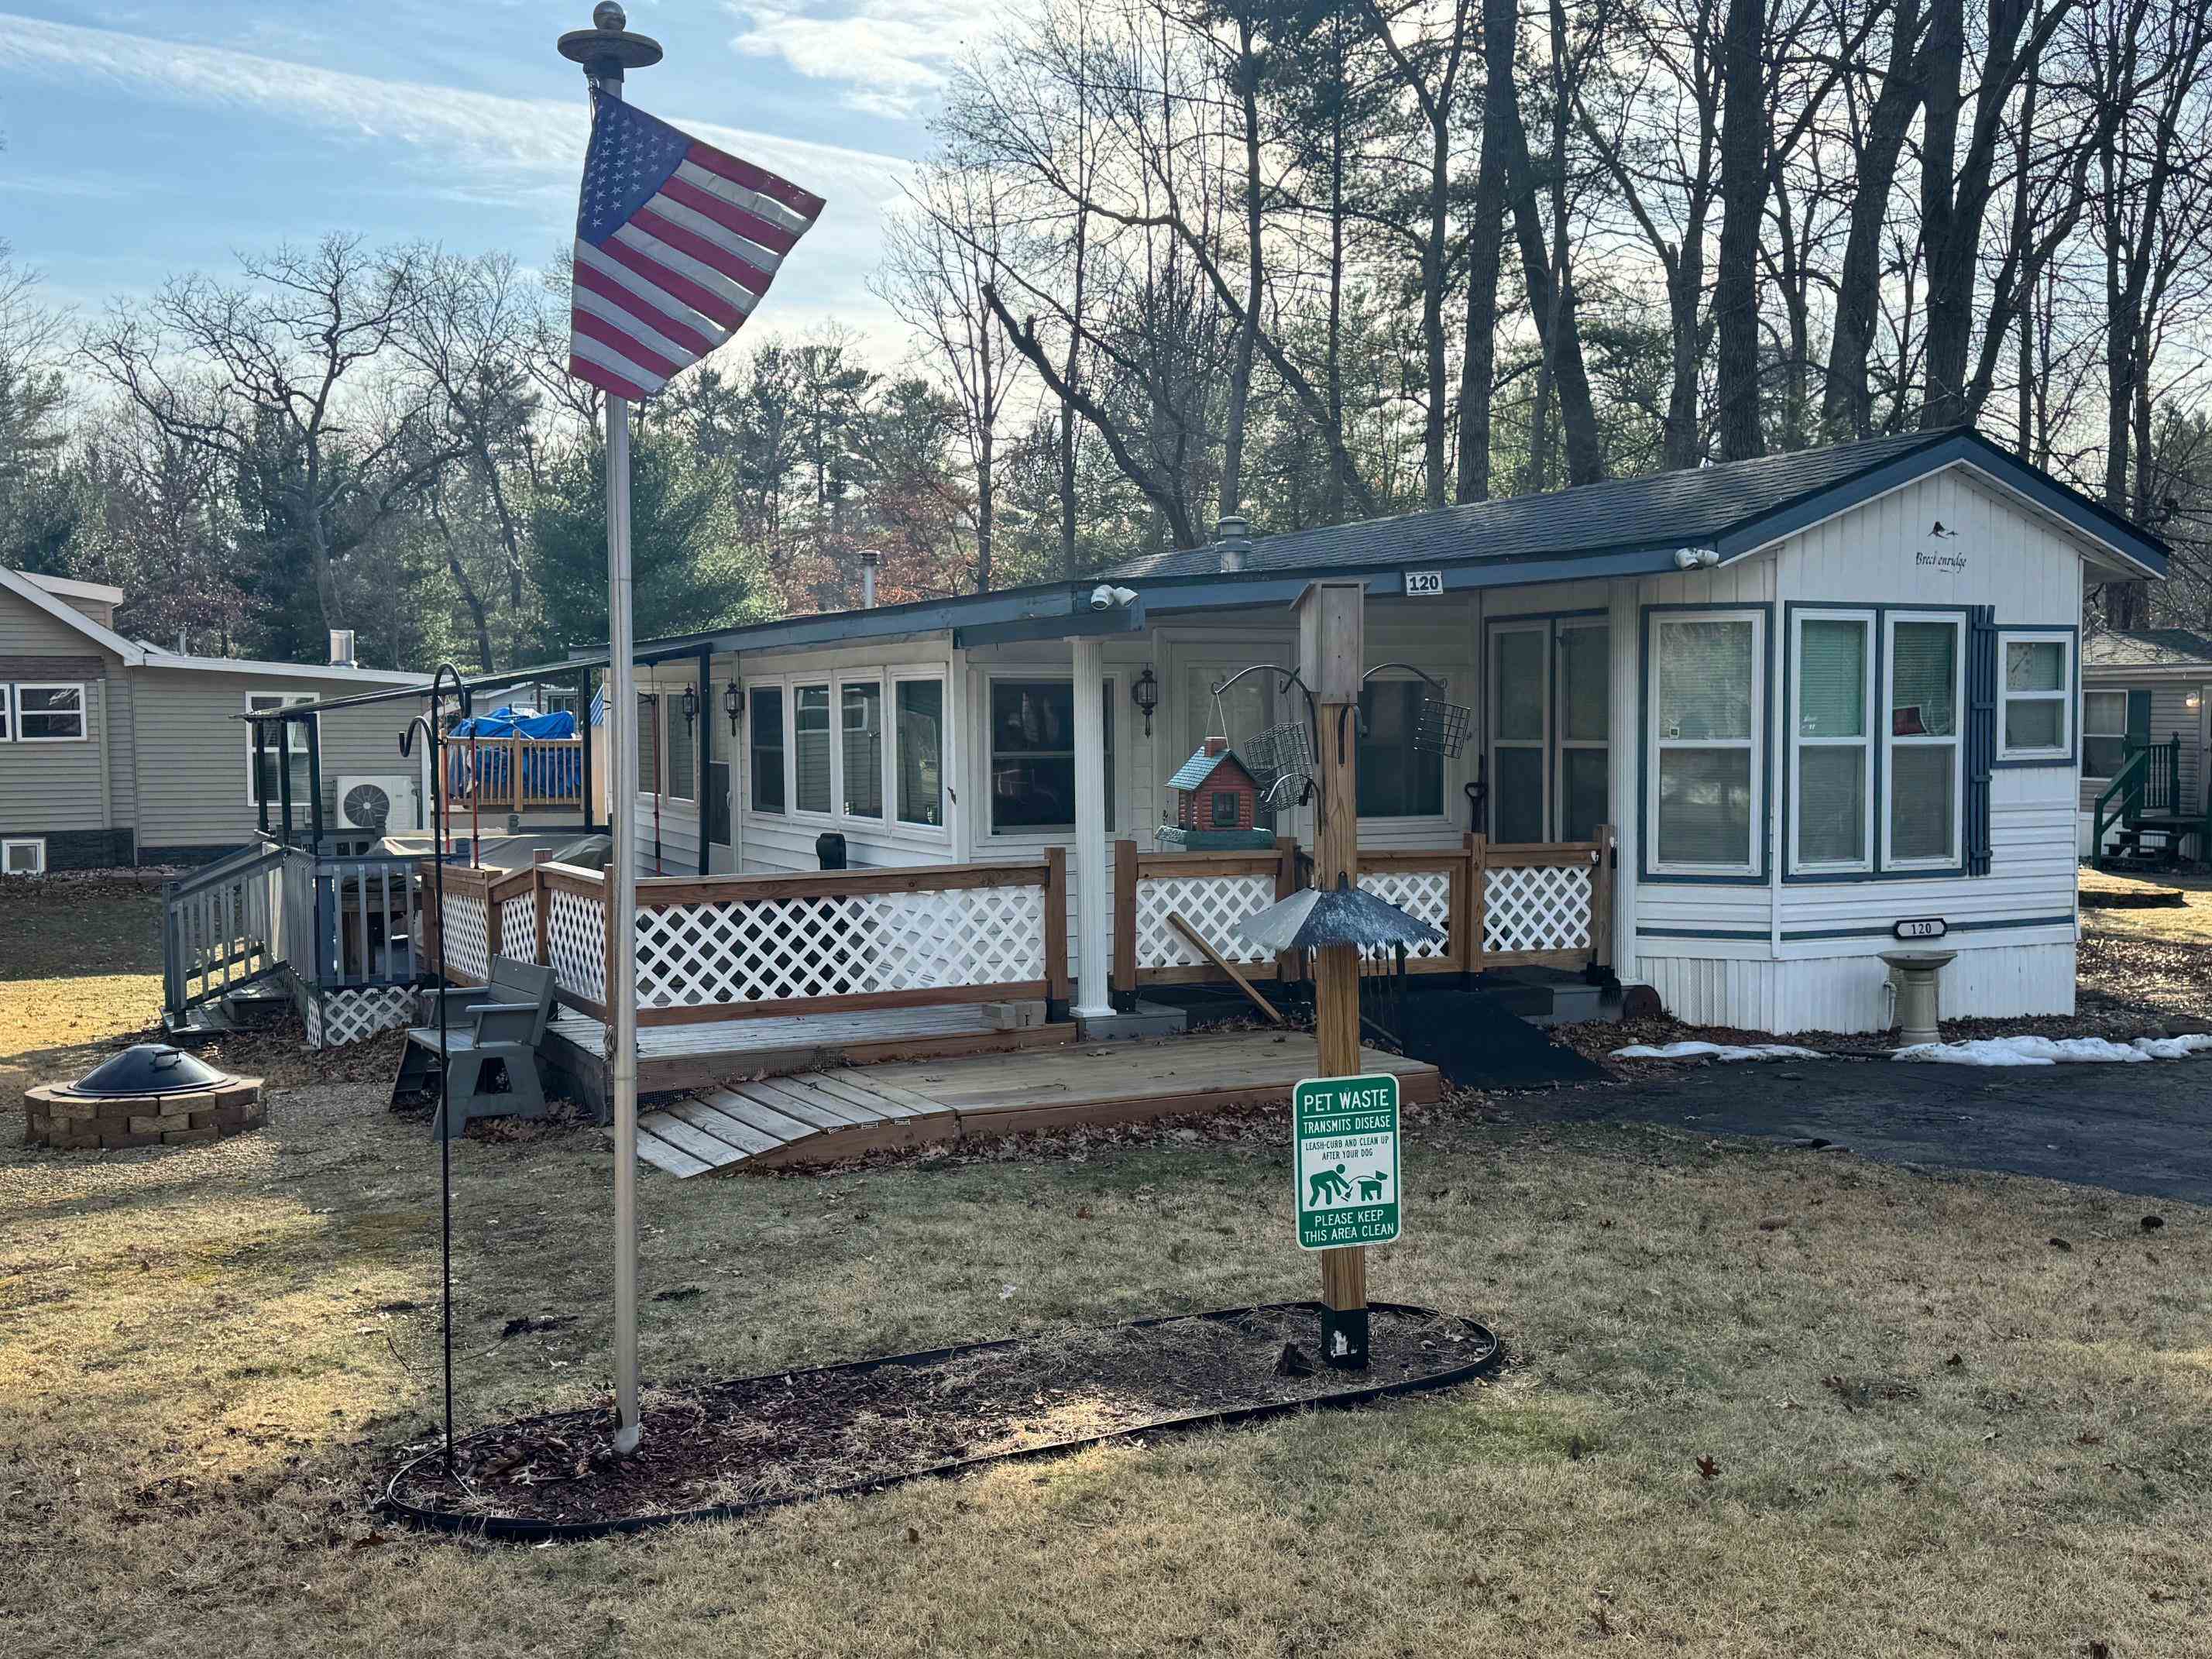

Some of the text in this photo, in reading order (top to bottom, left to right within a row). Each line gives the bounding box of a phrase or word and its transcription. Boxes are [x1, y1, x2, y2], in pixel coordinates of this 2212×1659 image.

[1410, 575, 1439, 591] 120
[1911, 923, 1932, 934] 120
[1304, 1088, 1389, 1112] PET WASTE
[1304, 1115, 1391, 1134] TRANSMITS DISEASE
[1305, 1135, 1389, 1151] LEASH-CURB AND CLEAN UP
[1322, 1148, 1373, 1161] AFTER YOUR DOG
[1315, 1210, 1384, 1227] PLEASE KEEP
[1304, 1222, 1394, 1242] THIS AREA CLEAN
